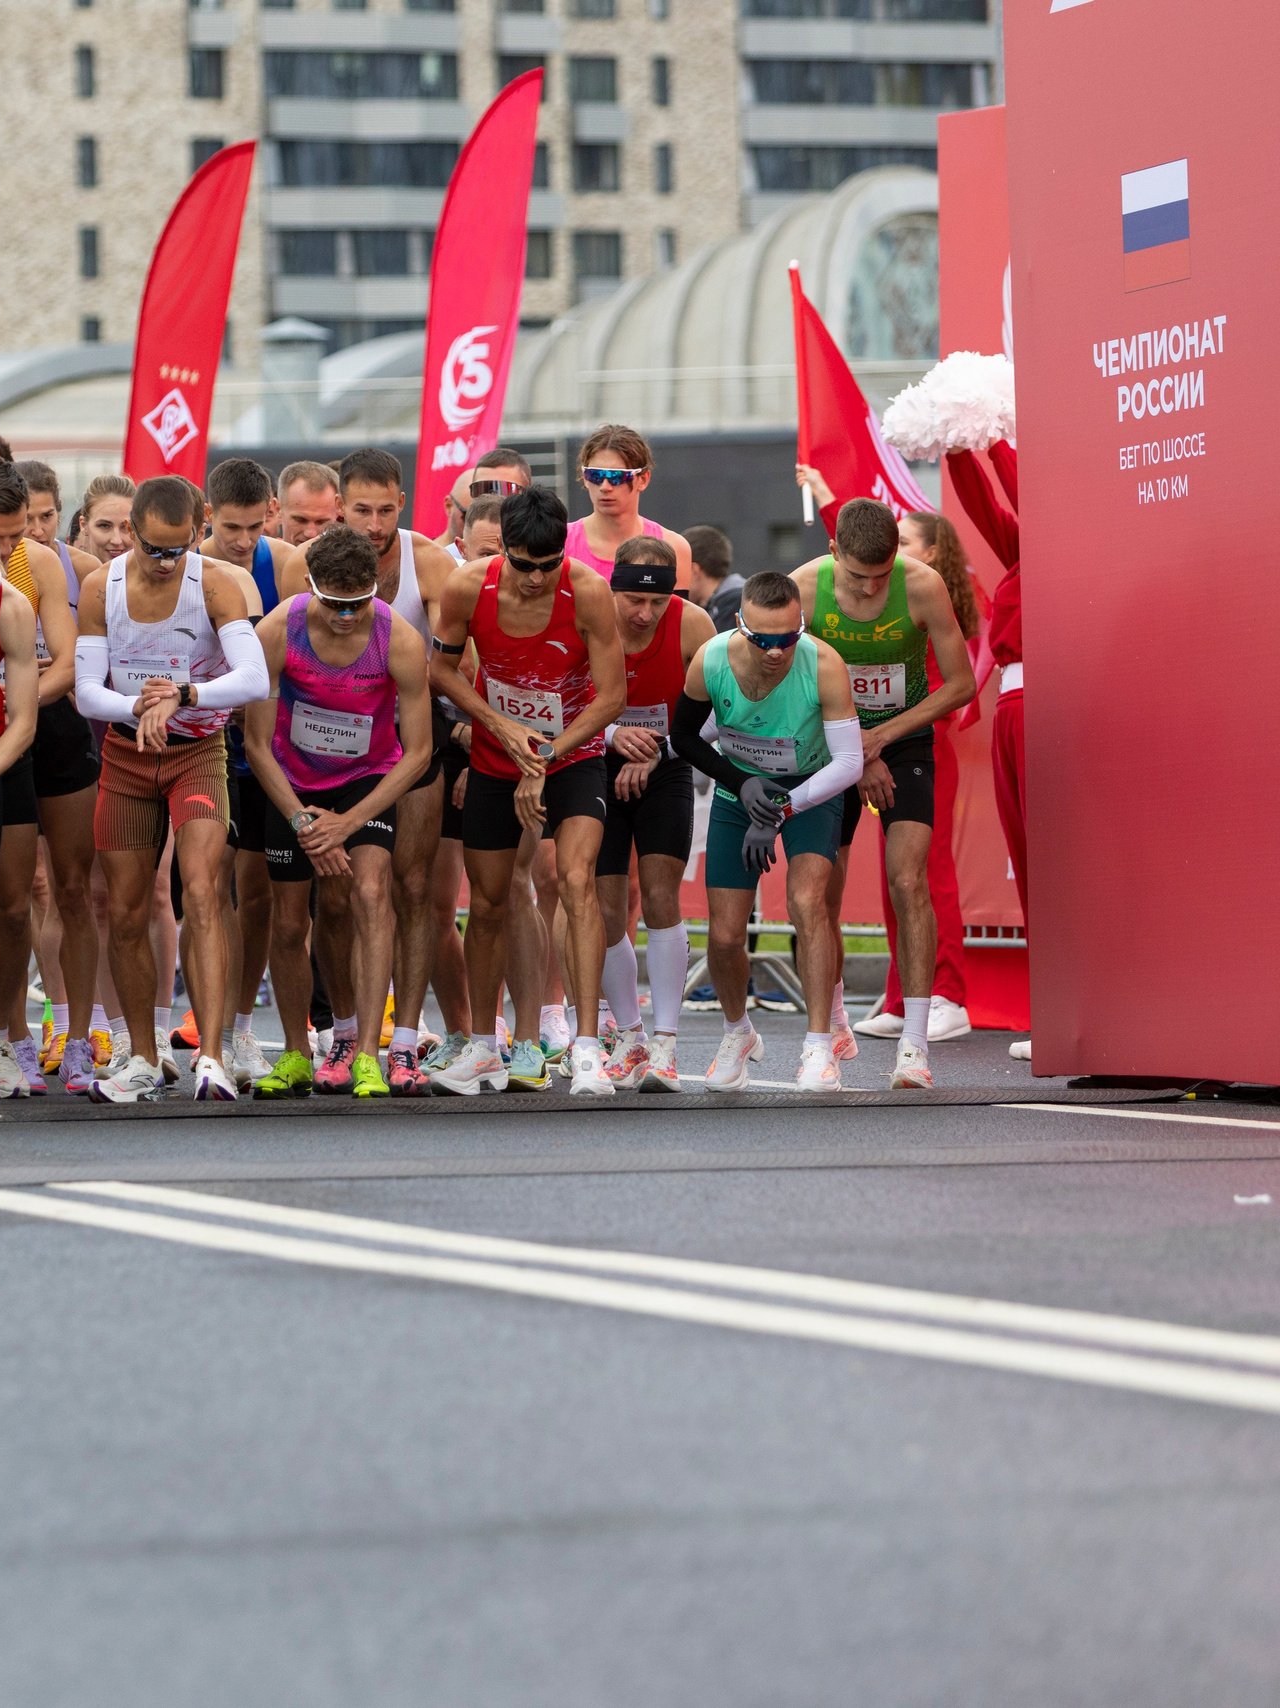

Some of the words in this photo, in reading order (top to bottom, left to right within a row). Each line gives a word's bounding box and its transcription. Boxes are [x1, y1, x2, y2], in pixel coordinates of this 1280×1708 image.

[1093, 315, 1226, 377] ЧЕМПИОНАТ
[1117, 369, 1205, 422] РОССИИ
[1119, 445, 1140, 470] БЕГ
[1142, 441, 1161, 466] ПО
[1163, 432, 1206, 462] ШОССЕ
[1138, 480, 1156, 505] НА
[1156, 478, 1169, 501] 10
[1171, 474, 1189, 499] КМ
[822, 628, 904, 642] DUCKS
[853, 677, 891, 694] 811
[497, 695, 554, 721] 1524
[304, 722, 357, 738] НЕДЕЛИН
[732, 743, 782, 756] НИКИТИН
